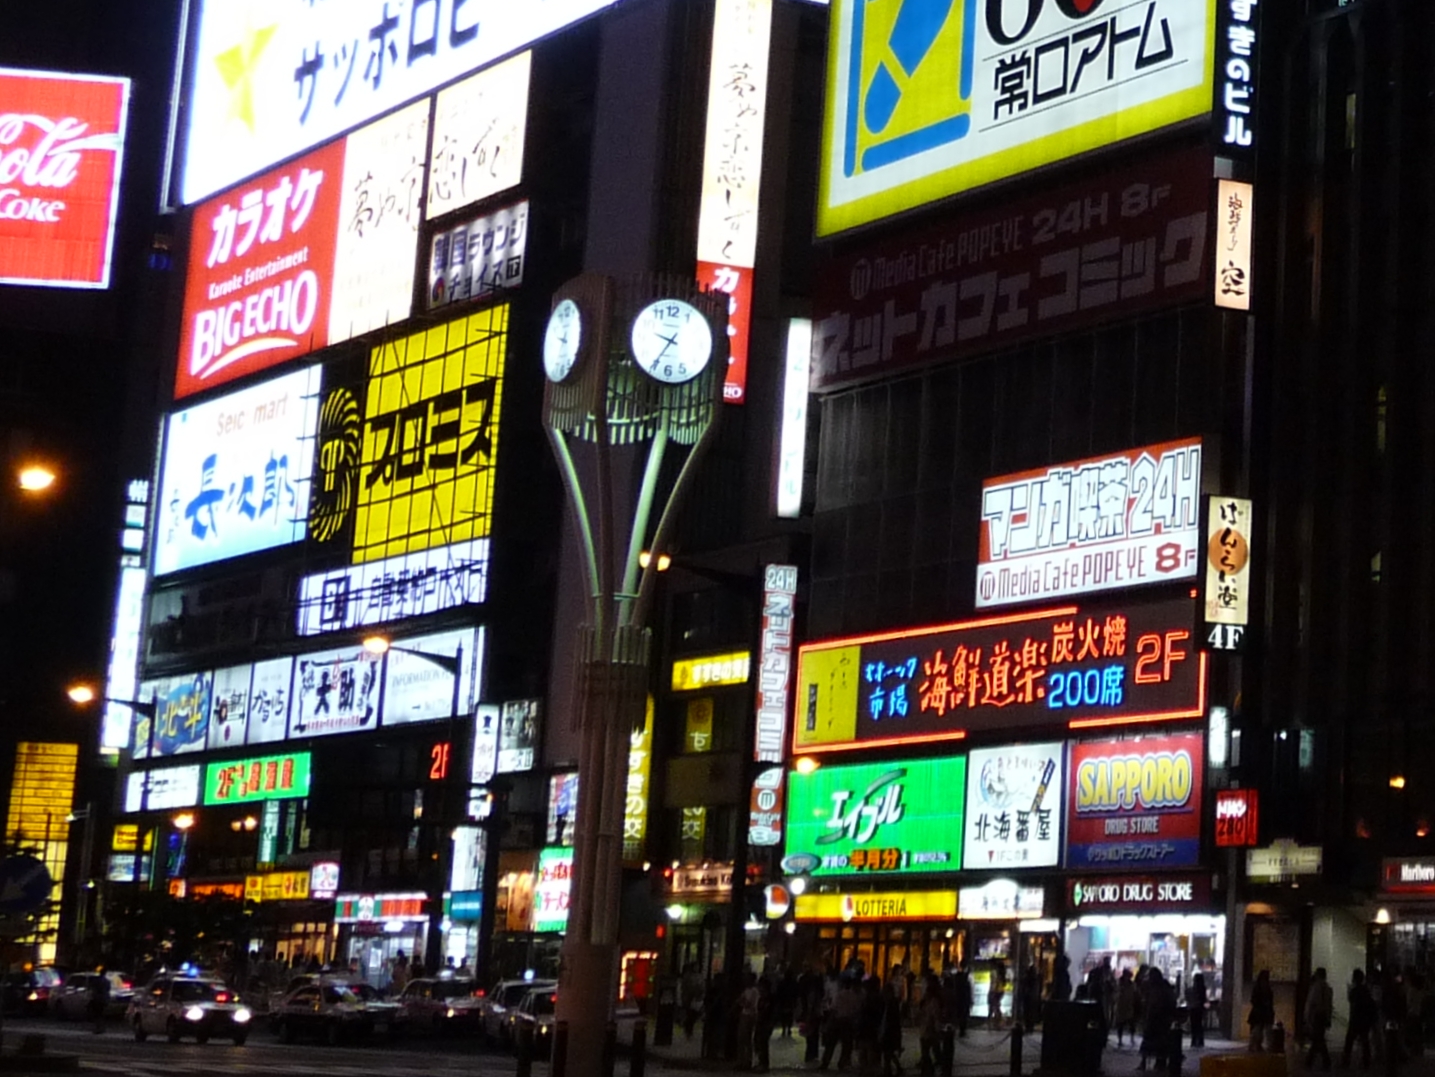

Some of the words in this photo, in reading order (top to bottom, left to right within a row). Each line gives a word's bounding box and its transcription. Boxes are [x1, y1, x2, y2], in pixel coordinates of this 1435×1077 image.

[993, 1, 1175, 122] 常口アトム
[0, 116, 89, 188] ola
[207, 168, 324, 269] カラオケ
[918, 237, 956, 276] Cafe
[957, 216, 1024, 267] POPEYE
[1031, 190, 1108, 245] 24H
[1119, 182, 1172, 218] 8F
[208, 274, 243, 300] Karaoke
[245, 245, 310, 286] Entertainment
[812, 270, 1031, 378] ネットカフェ
[1037, 211, 1208, 321] コミック
[190, 301, 244, 377] BIG
[242, 269, 318, 341] ECHO
[666, 305, 680, 318] 12
[365, 378, 497, 490] プロミス
[184, 447, 296, 541] 長次郎
[765, 565, 797, 593] 24H
[998, 565, 1040, 599] Media
[1043, 557, 1079, 592] Cafe
[1082, 545, 1148, 586] POPEYE
[1155, 541, 1197, 574] 8F
[1051, 614, 1127, 664] 炭火焼
[1134, 630, 1190, 684] 2F
[1207, 624, 1245, 650] 4F
[868, 683, 909, 721] 市場
[918, 637, 1048, 716] 海鮮道楽
[1048, 664, 1125, 709] 200席
[1077, 750, 1193, 812] SAPPORO
[825, 783, 906, 845] エイブル
[973, 808, 1053, 844] 北海番屋
[1104, 817, 1128, 836] DRUG
[1129, 815, 1160, 834] STORE
[1122, 882, 1154, 901] DRUG
[1157, 881, 1194, 902] STORE
[1401, 863, 1435, 882] Marlboro
[855, 898, 907, 917] LOTTERIA
